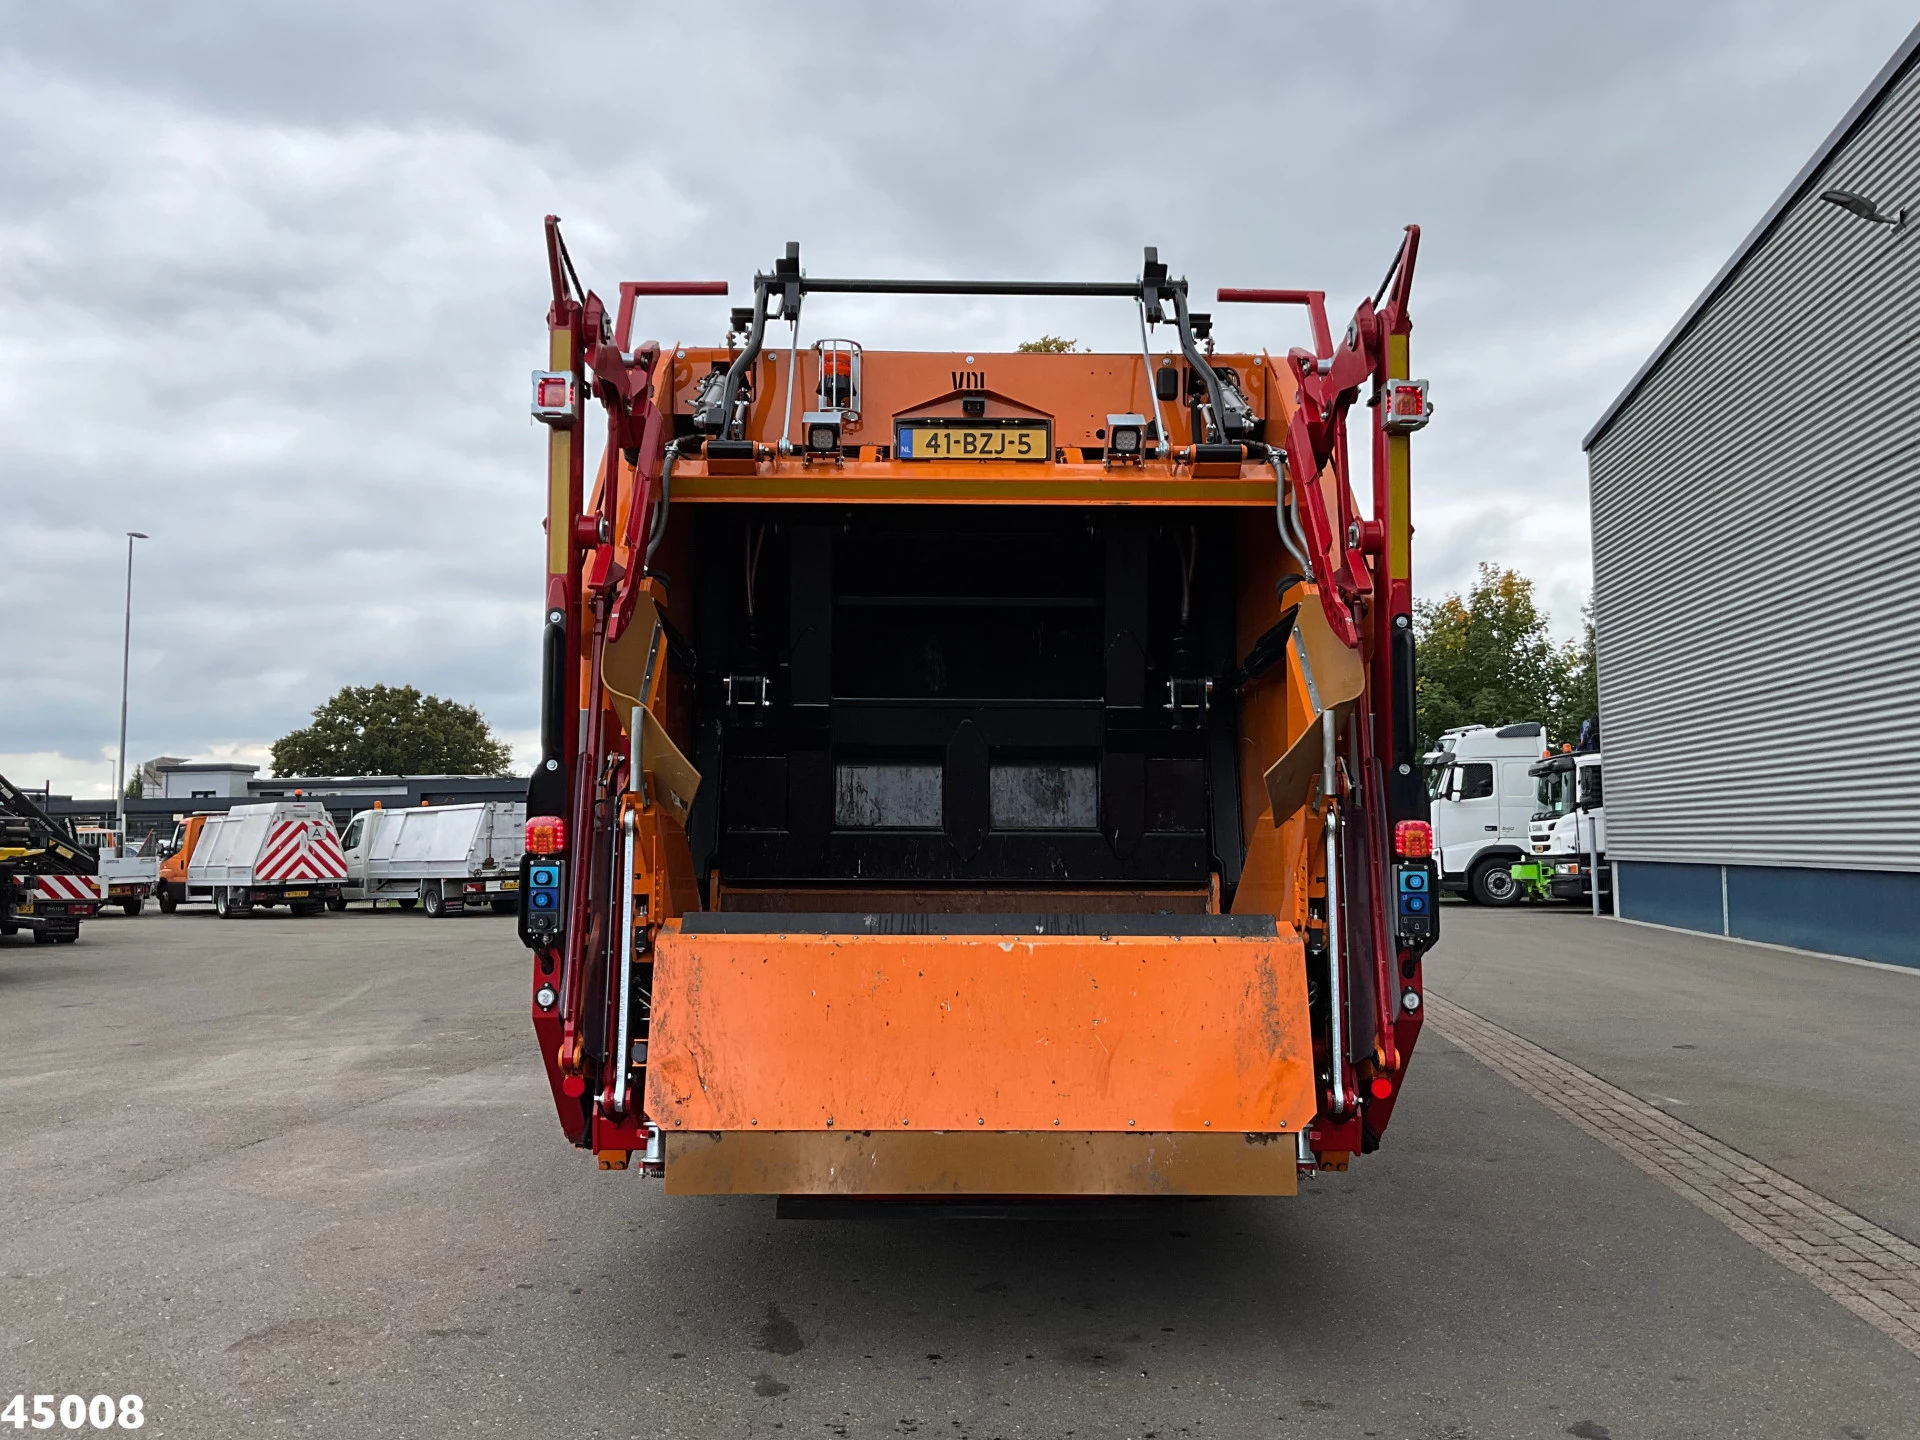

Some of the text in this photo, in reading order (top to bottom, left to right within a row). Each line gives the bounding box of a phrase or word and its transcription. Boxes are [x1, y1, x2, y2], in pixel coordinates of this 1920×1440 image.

[925, 432, 1032, 455] 41-BZJ-5
[901, 445, 911, 453] NL
[312, 828, 322, 838] A
